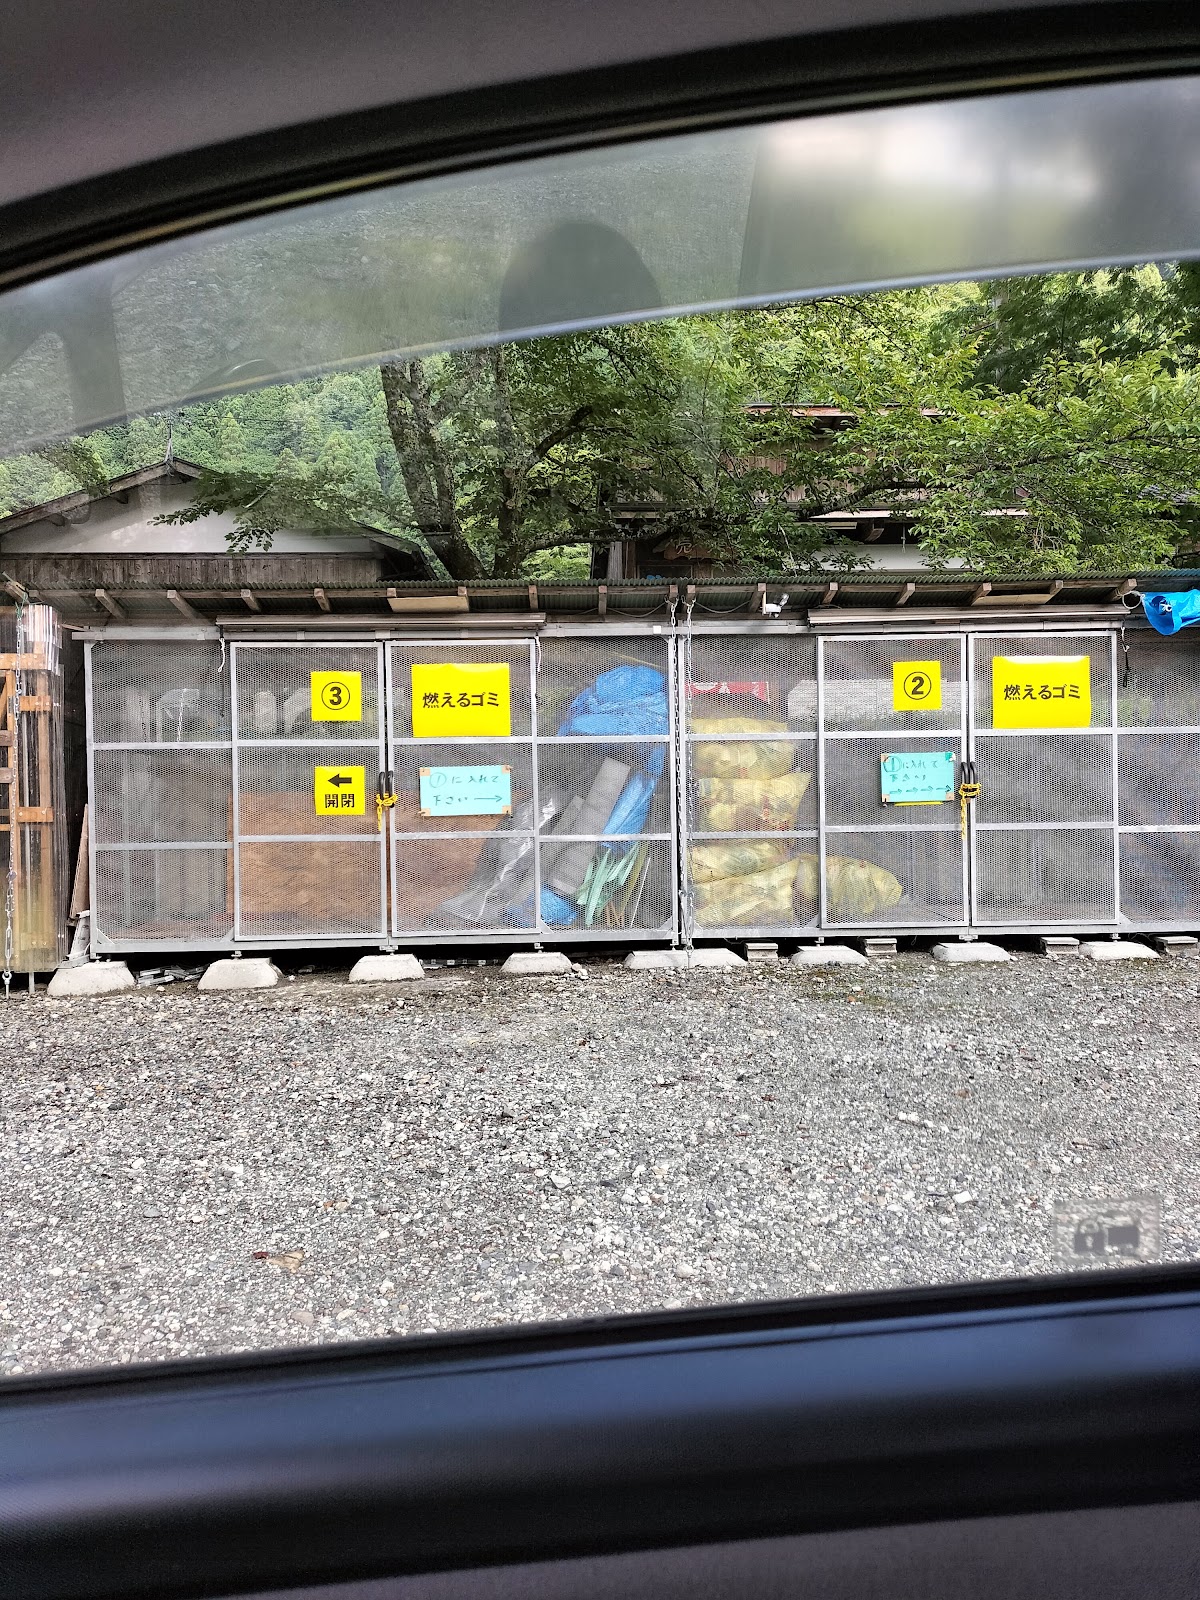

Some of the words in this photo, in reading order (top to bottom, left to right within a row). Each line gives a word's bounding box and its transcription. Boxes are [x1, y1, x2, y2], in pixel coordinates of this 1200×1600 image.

[422, 691, 500, 709] 燃えるゴミ
[1004, 683, 1081, 701] 燃えるゴミ
[324, 793, 355, 809] 開閉
